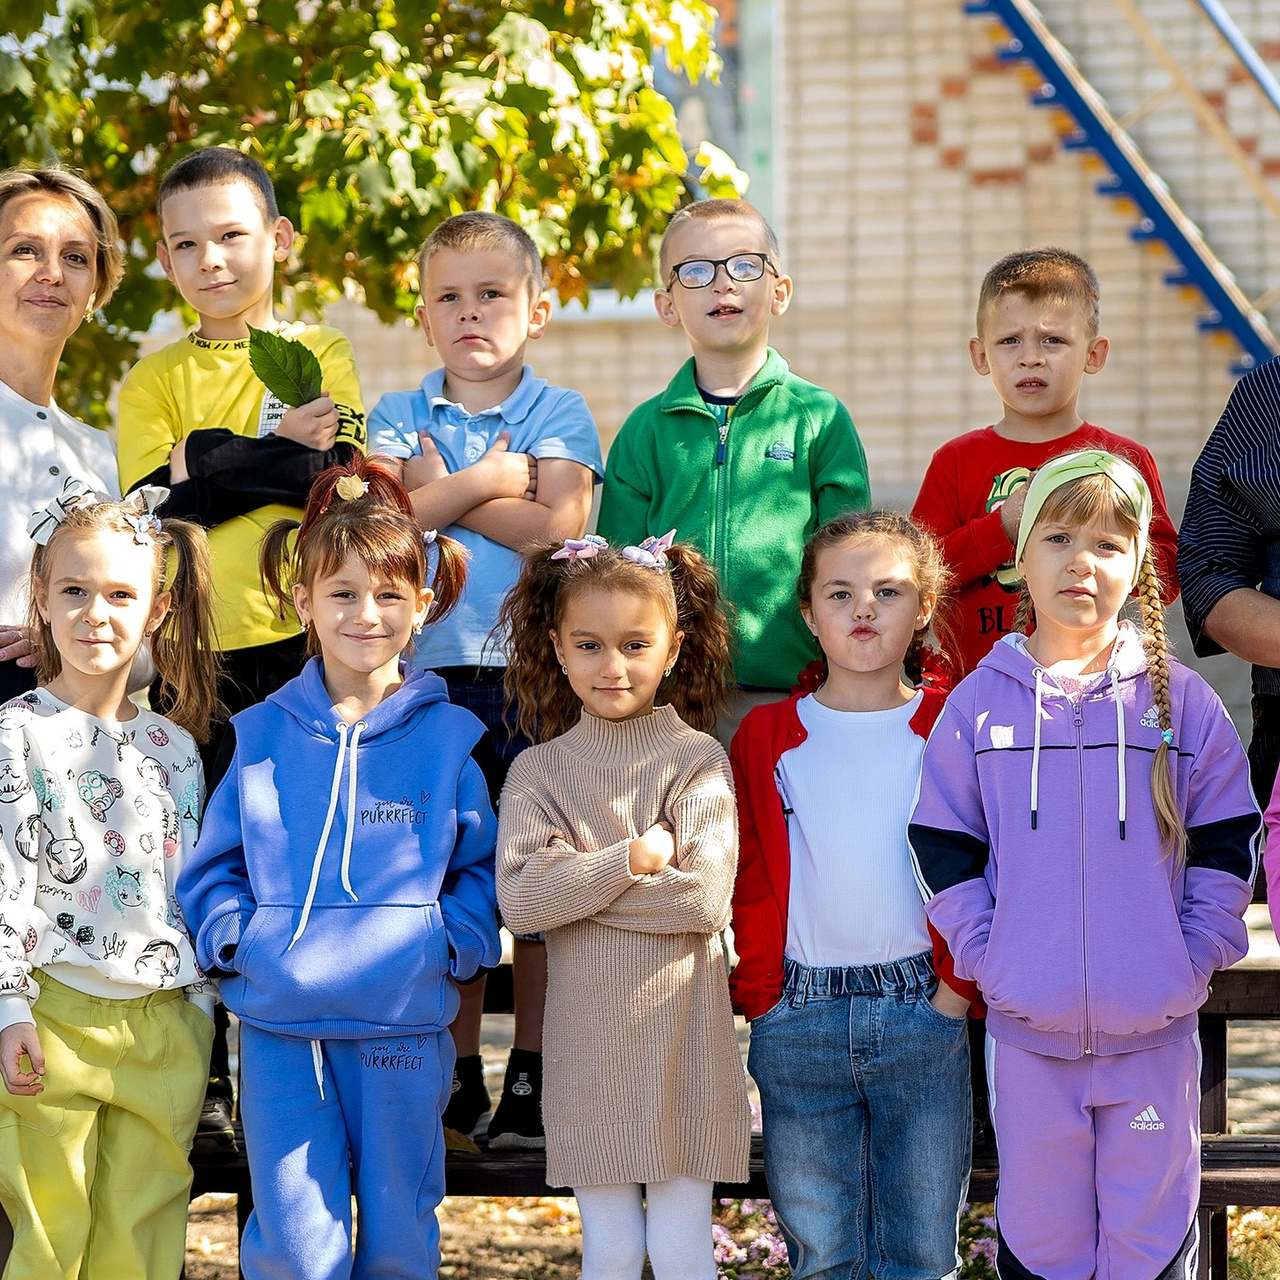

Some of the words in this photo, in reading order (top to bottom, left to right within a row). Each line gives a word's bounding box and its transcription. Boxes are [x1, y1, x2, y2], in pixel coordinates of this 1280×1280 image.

[234, 340, 250, 350] NE
[374, 799, 395, 809] you
[400, 795, 415, 807] are
[361, 807, 428, 826] PURRRFECT
[102, 931, 128, 960] Lily
[370, 1044, 392, 1055] you
[396, 1041, 412, 1053] are
[360, 1051, 424, 1071] PURRRFECT
[1129, 1119, 1165, 1131] adidas
